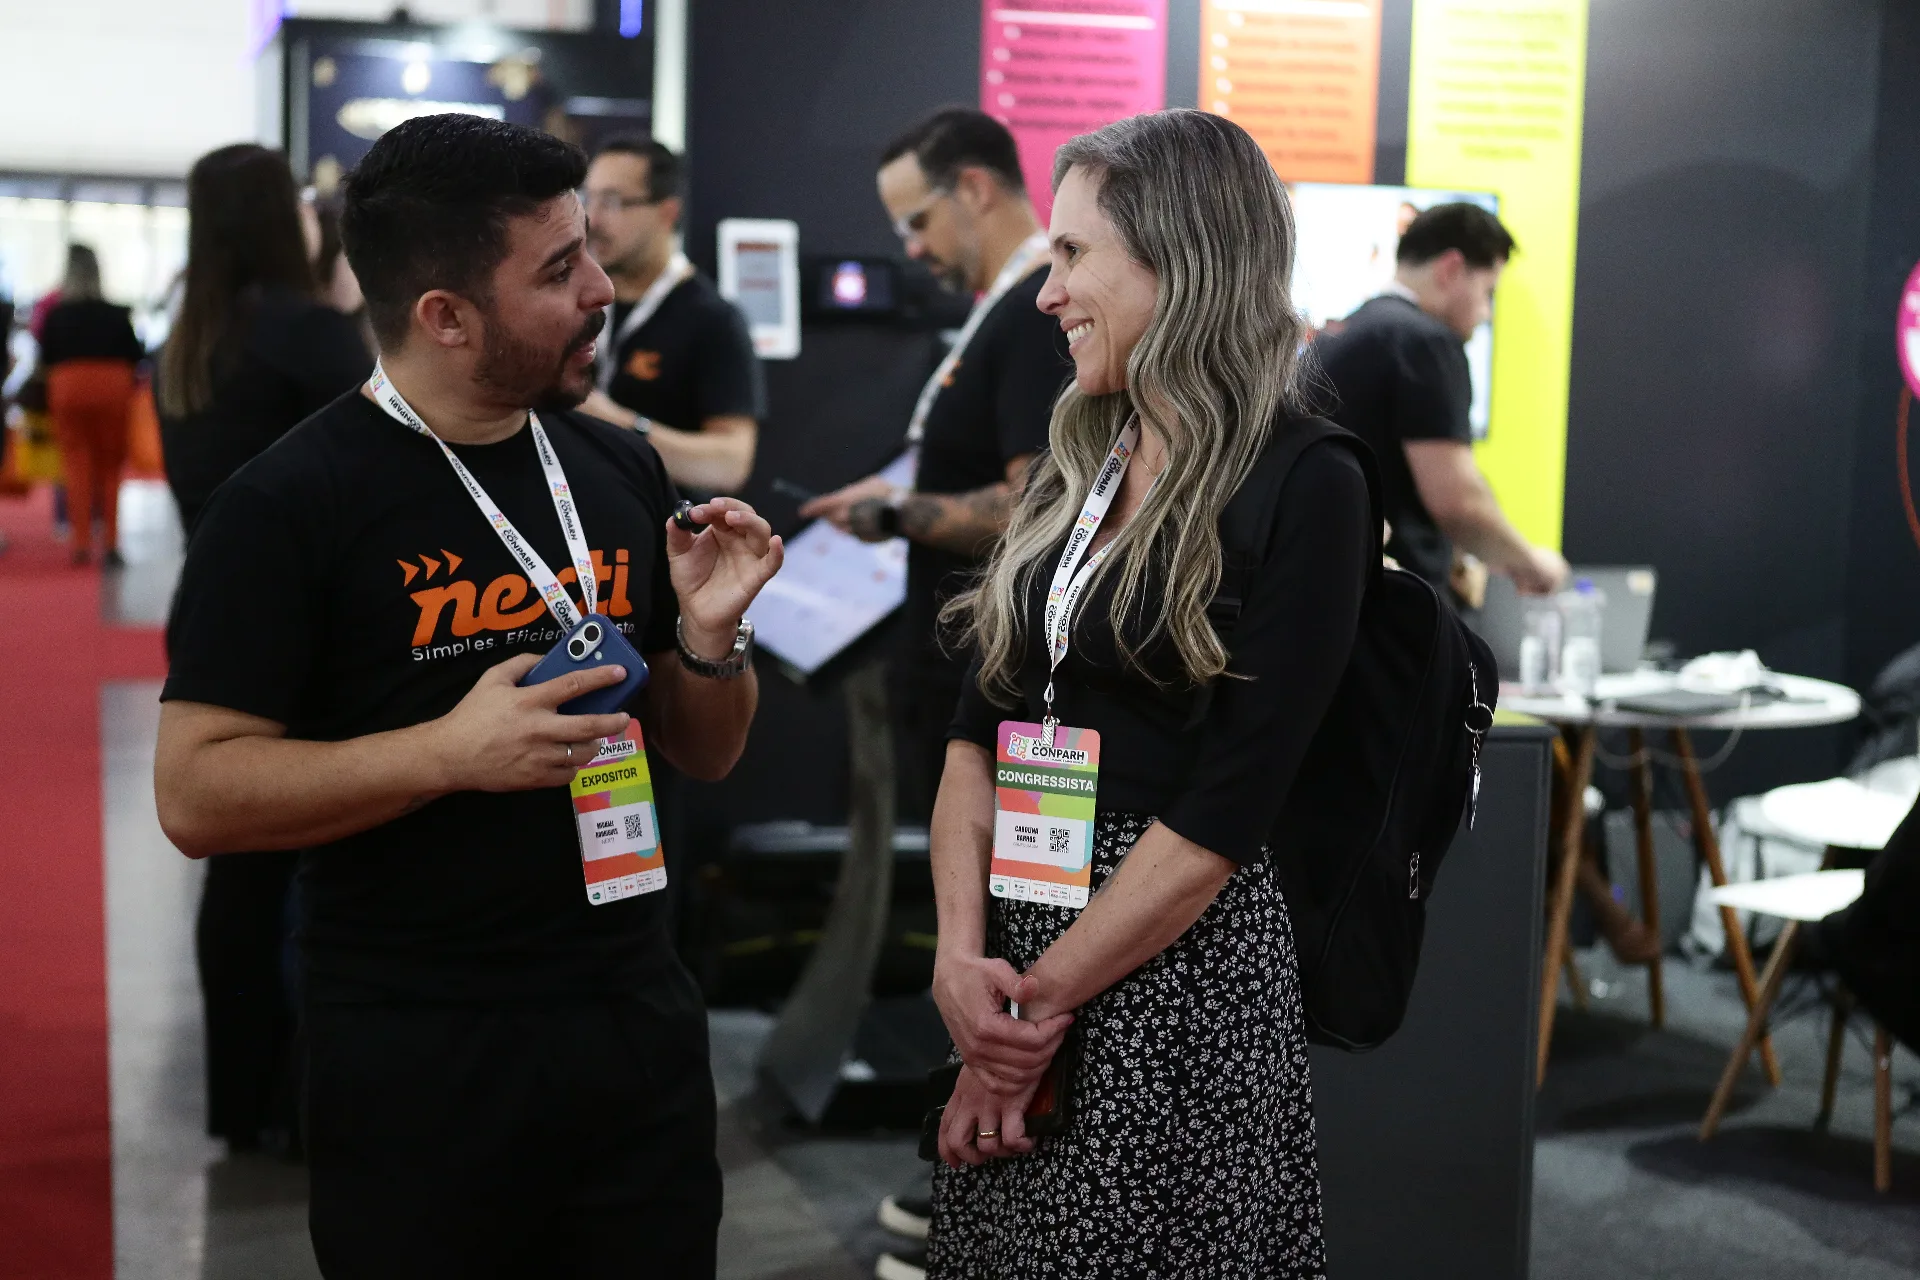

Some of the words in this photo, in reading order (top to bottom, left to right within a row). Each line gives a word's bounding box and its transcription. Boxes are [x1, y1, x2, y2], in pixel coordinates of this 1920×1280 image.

[1095, 457, 1119, 497] CONPARH
[560, 499, 578, 540] CONPARH
[503, 529, 537, 570] CONPARH
[1062, 528, 1085, 568] CONPARH
[1059, 585, 1080, 632] CONPARH
[506, 627, 566, 645] Eficien
[596, 741, 634, 756] ONPARH
[1032, 747, 1085, 761] CONPARH
[581, 767, 638, 788] EXPOSITOR
[997, 770, 1095, 792] CONGRESSISTA
